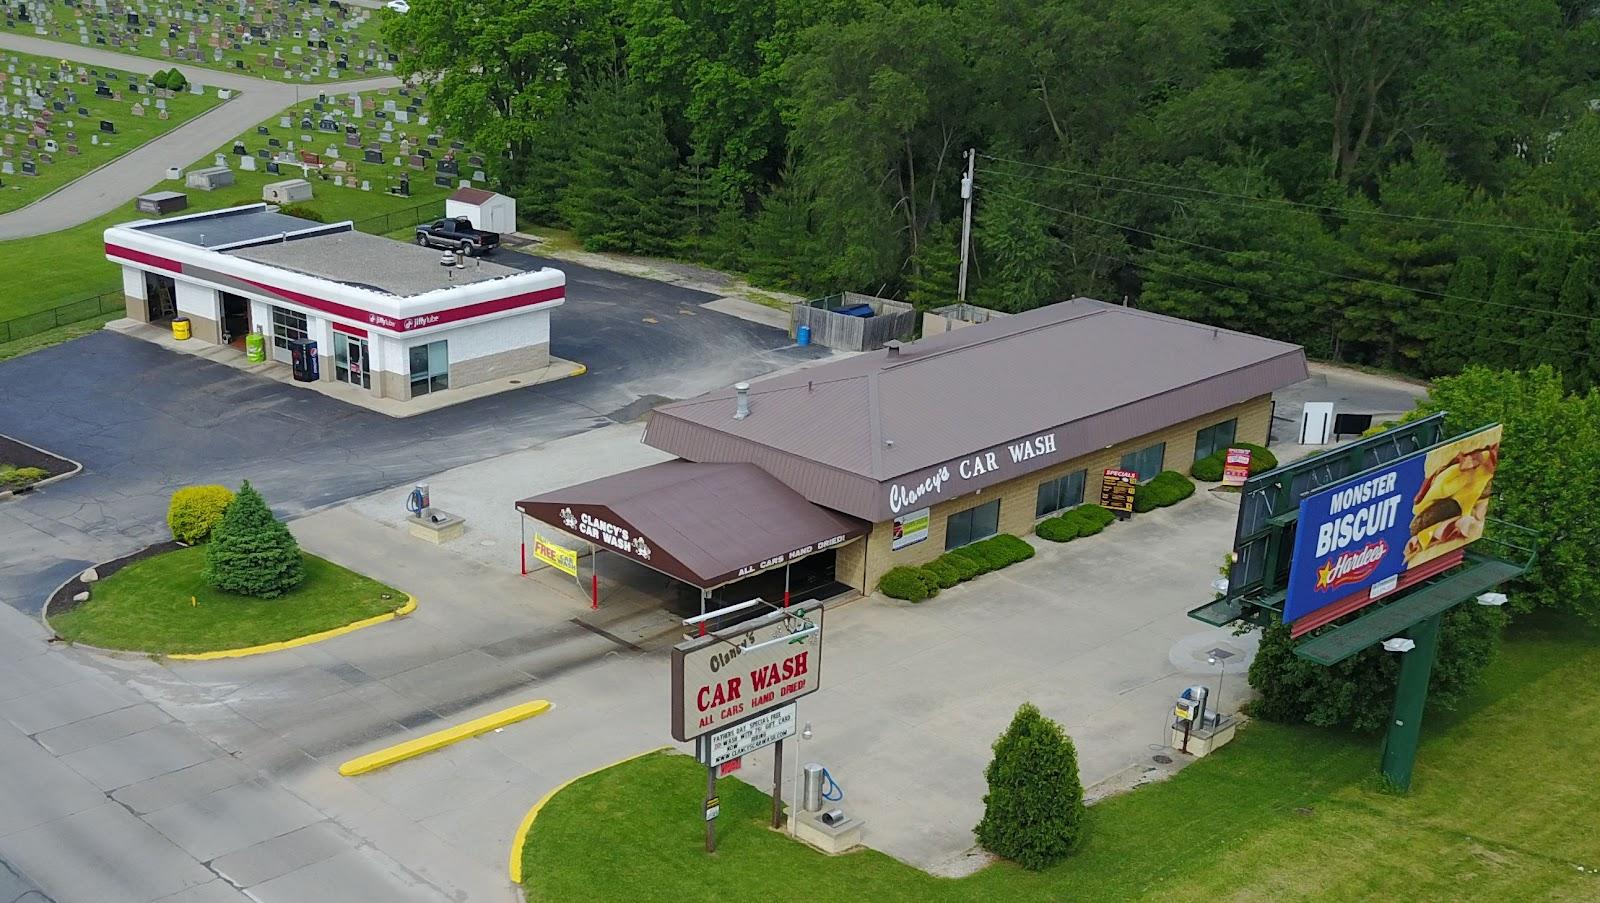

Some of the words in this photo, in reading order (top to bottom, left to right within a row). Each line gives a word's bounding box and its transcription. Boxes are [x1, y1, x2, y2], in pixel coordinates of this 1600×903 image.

[890, 466, 950, 513] Clancy's
[959, 452, 999, 480] CAR
[1008, 433, 1057, 464] WASH
[1106, 470, 1136, 478] SPECIALS
[1329, 471, 1397, 516] MONSTER
[579, 523, 599, 539] CAR
[602, 531, 631, 552] WASH
[580, 513, 629, 540] CLANCY'S
[1315, 494, 1402, 559] BISCUIT
[535, 541, 557, 562] FREE
[738, 565, 756, 576] ALL
[760, 555, 784, 569] CARS
[788, 545, 813, 559] HAND
[817, 534, 846, 550] DRIED!
[1327, 540, 1387, 584] Hardee's
[697, 677, 742, 712] CAR
[750, 651, 808, 692] WASH
[699, 715, 714, 728] ALL
[720, 703, 744, 720] CARS
[751, 691, 775, 708] HAND
[780, 679, 806, 697] DRIED!
[723, 736, 738, 746] WASH
[779, 714, 790, 725] CARD
[736, 724, 746, 734] DAY
[750, 717, 769, 728] SPECIAL
[771, 711, 781, 720] FREE
[727, 743, 738, 751] NOW
